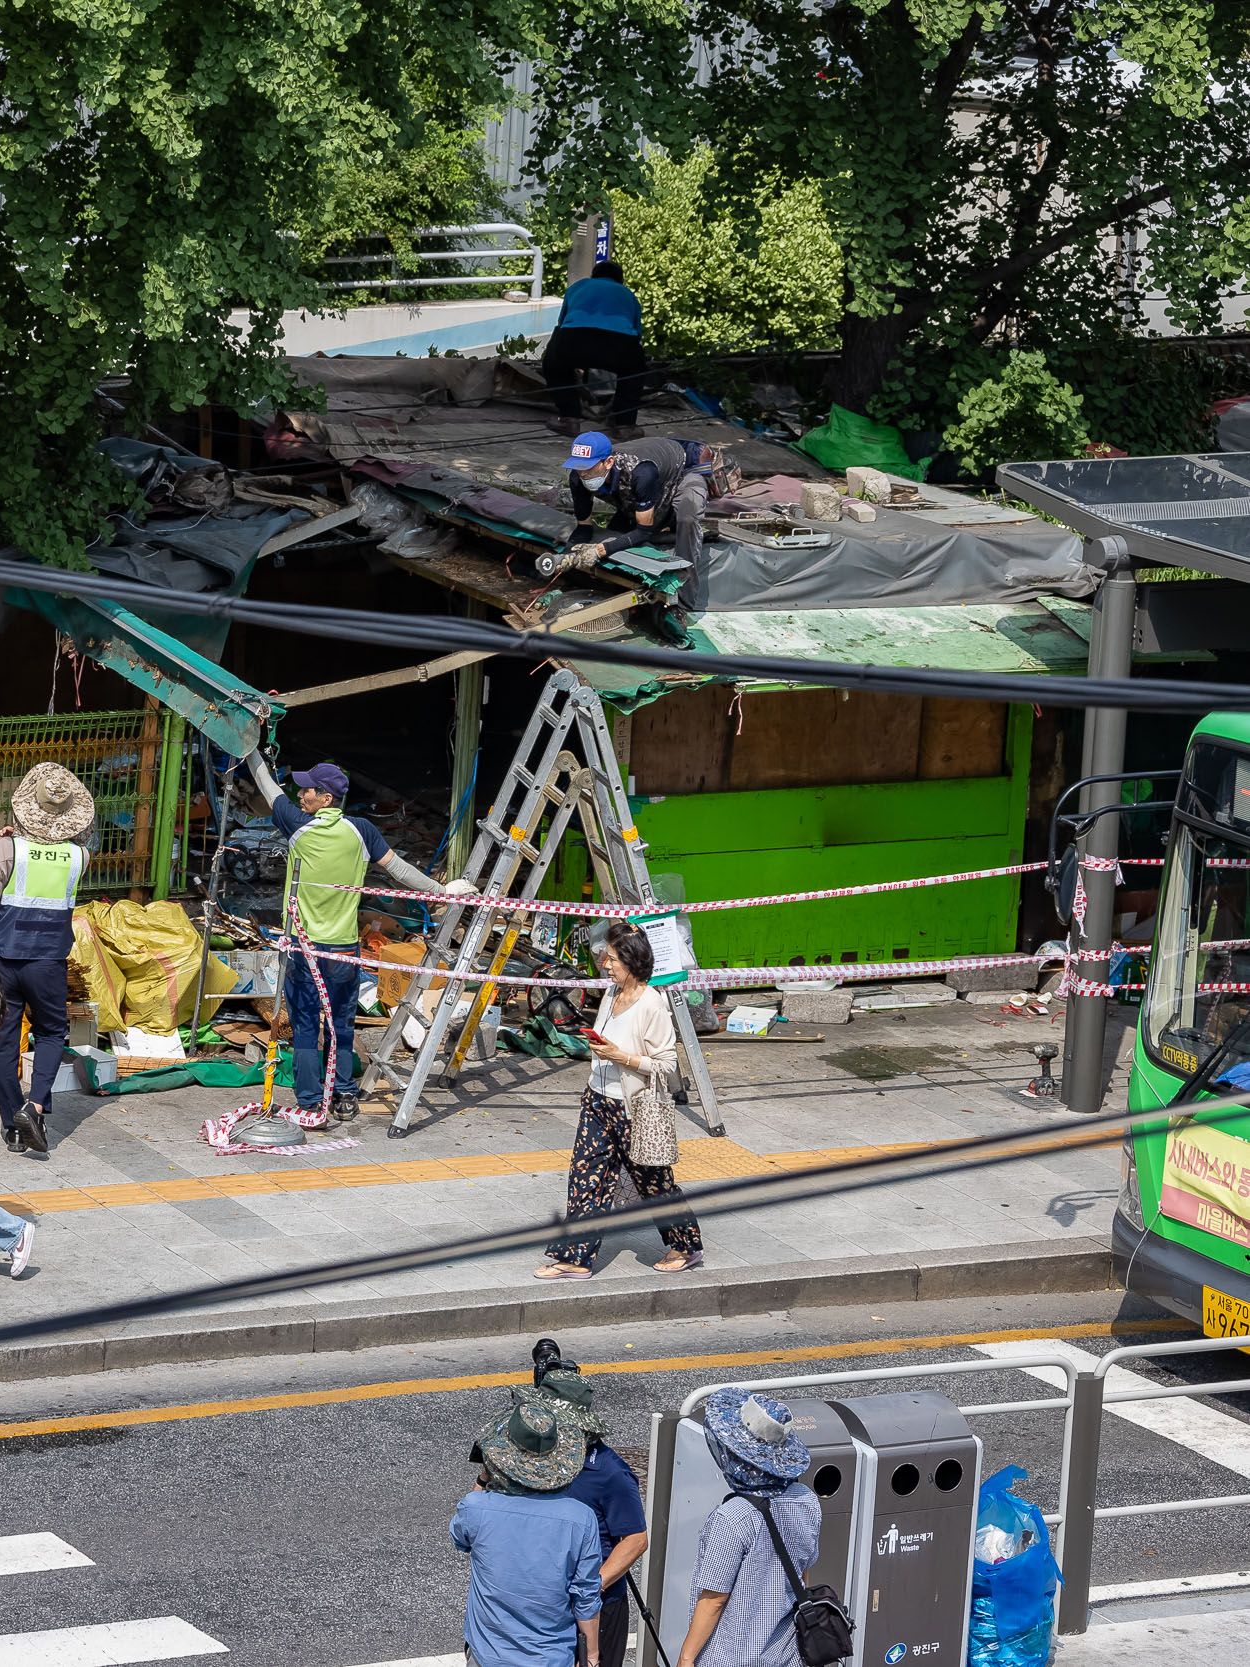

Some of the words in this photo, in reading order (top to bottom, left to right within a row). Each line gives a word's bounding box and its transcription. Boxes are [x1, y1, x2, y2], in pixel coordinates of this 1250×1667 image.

[597, 221, 608, 264] 출차
[28, 849, 71, 862] 광진구
[1168, 1138, 1236, 1191] 시내버스와
[1197, 1202, 1249, 1243] 마을버스
[1218, 1295, 1232, 1312] 서울
[1235, 1302, 1249, 1319] 70
[1206, 1307, 1216, 1329] 사
[1219, 1313, 1250, 1337] 967
[900, 1531, 934, 1544] 일반쓰레기
[912, 1642, 940, 1656] 광진구
